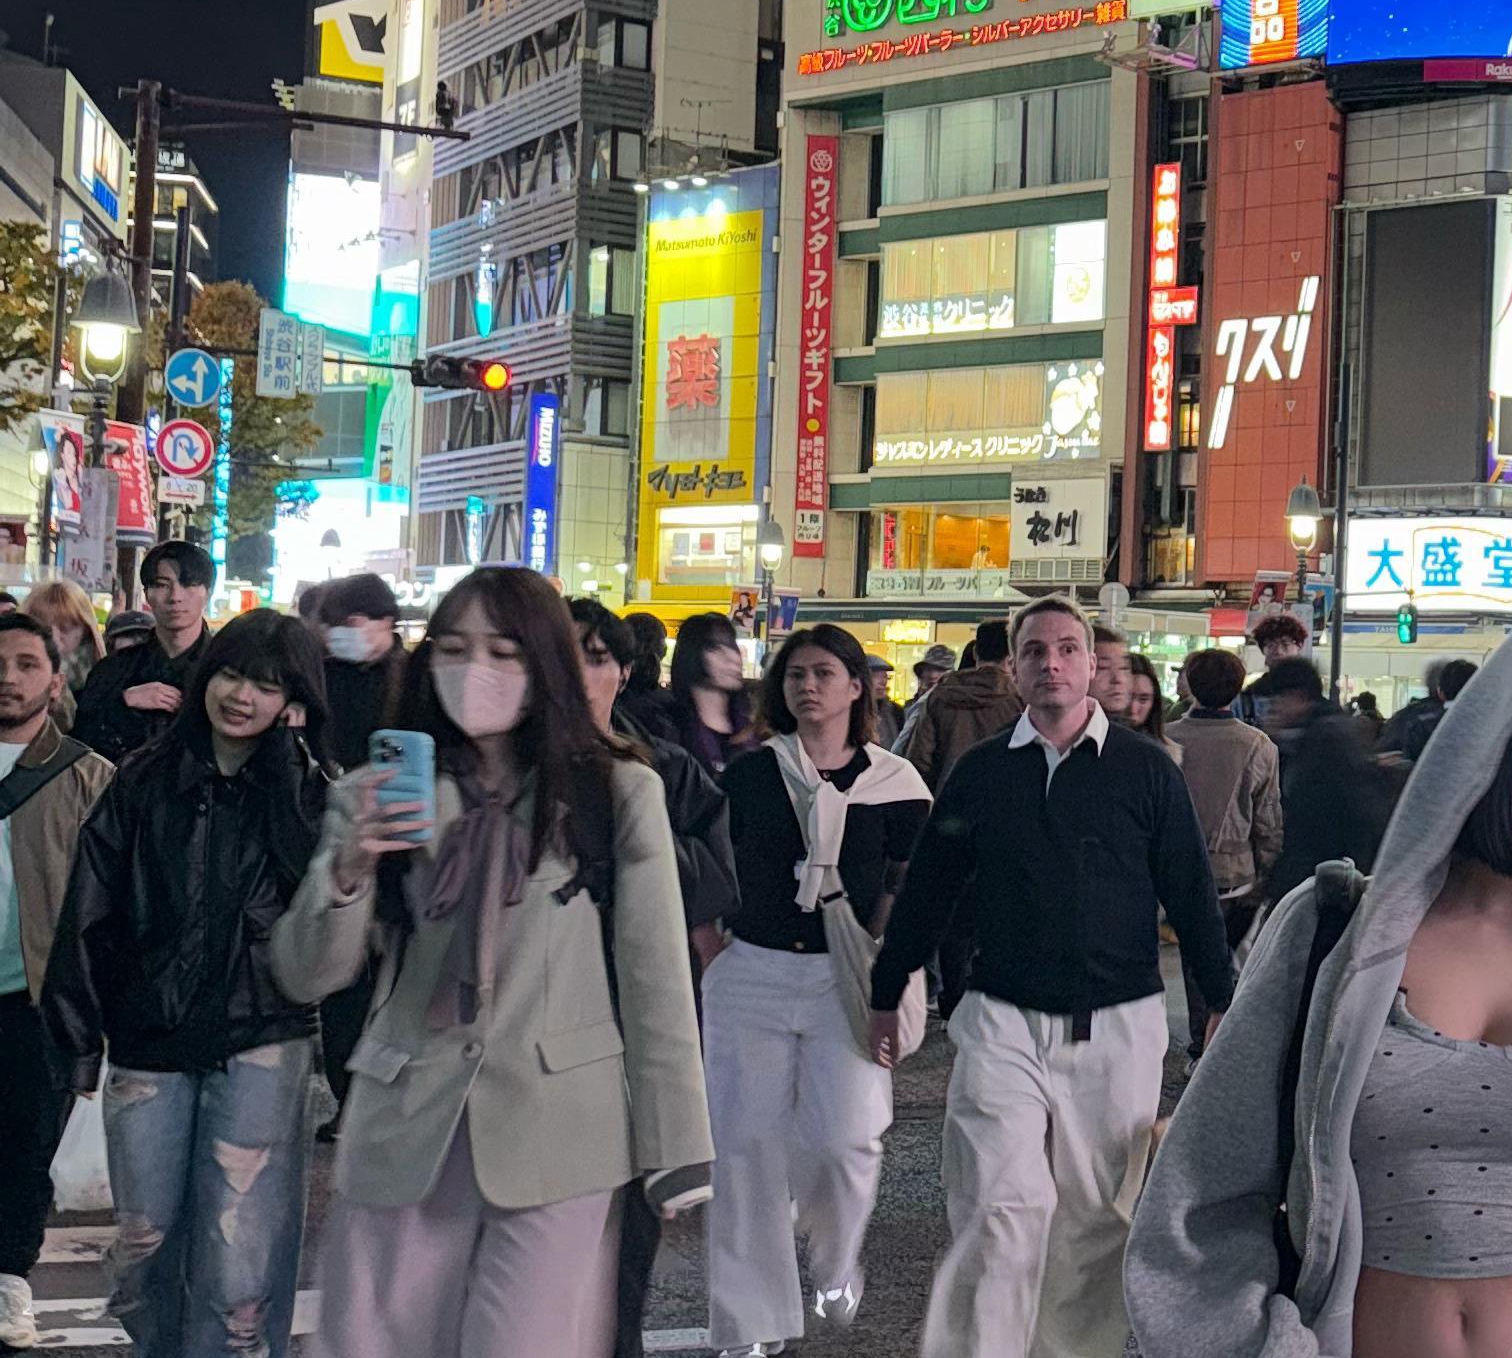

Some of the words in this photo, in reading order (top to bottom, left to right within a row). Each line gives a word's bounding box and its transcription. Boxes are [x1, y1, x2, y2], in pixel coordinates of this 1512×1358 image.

[655, 232, 715, 253] Matsumoto
[717, 227, 757, 246] KiYoshi
[804, 176, 831, 415] ウィンターフルーツギフト
[274, 318, 294, 391] 渋谷駅前
[666, 334, 721, 411] 薬
[538, 407, 555, 467] MIZUHO
